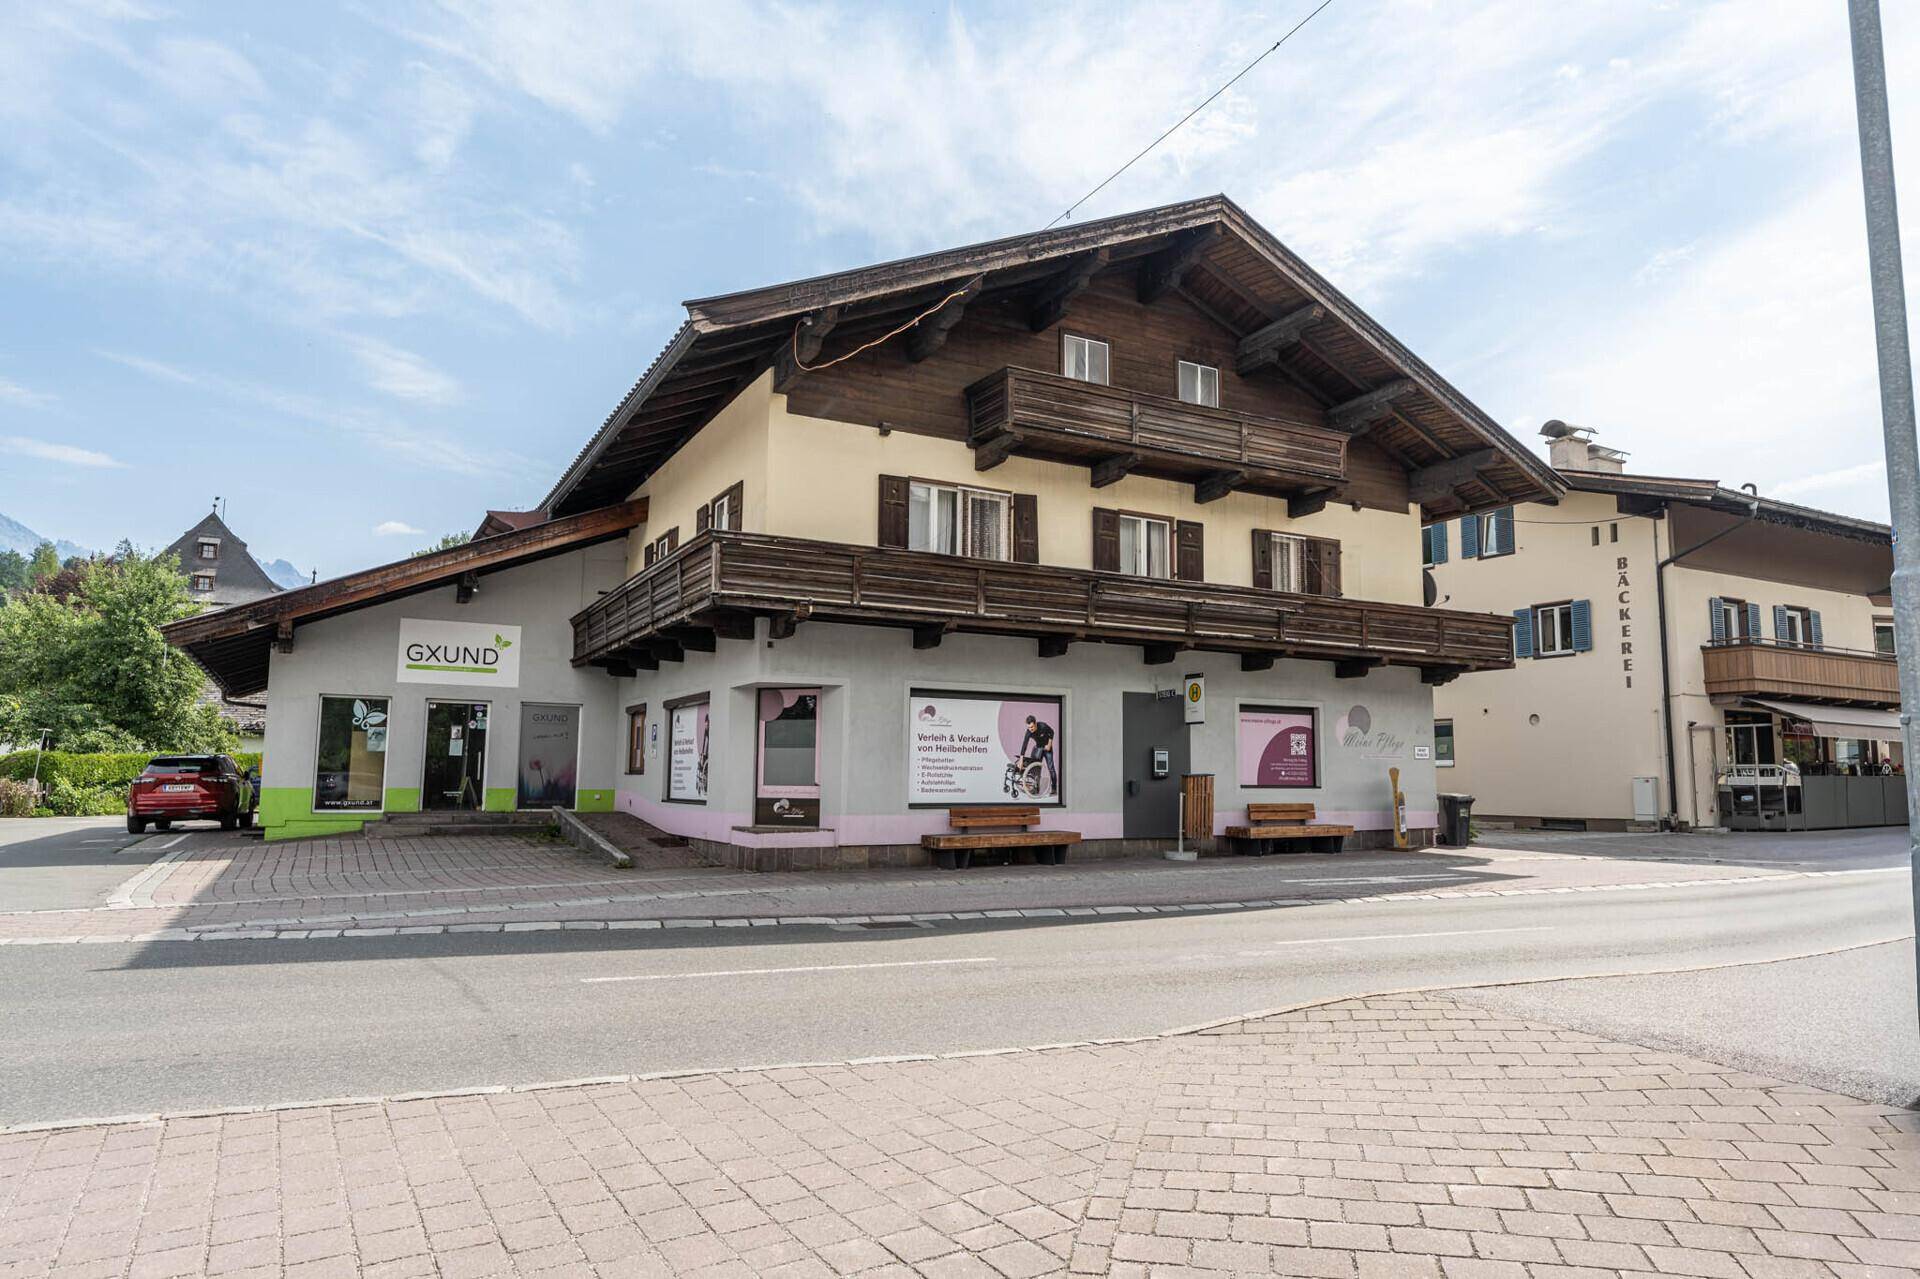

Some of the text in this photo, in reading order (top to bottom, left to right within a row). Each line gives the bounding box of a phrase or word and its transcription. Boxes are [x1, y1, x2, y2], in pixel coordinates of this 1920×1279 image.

[1617, 556, 1632, 689] BÄCKEREI
[406, 643, 499, 665] GXUND
[532, 713, 568, 722] GXUND
[917, 733, 990, 743] Verleih & Verkauf
[935, 744, 988, 753] Heilbehelfen
[324, 799, 374, 807] www.gxund.at
